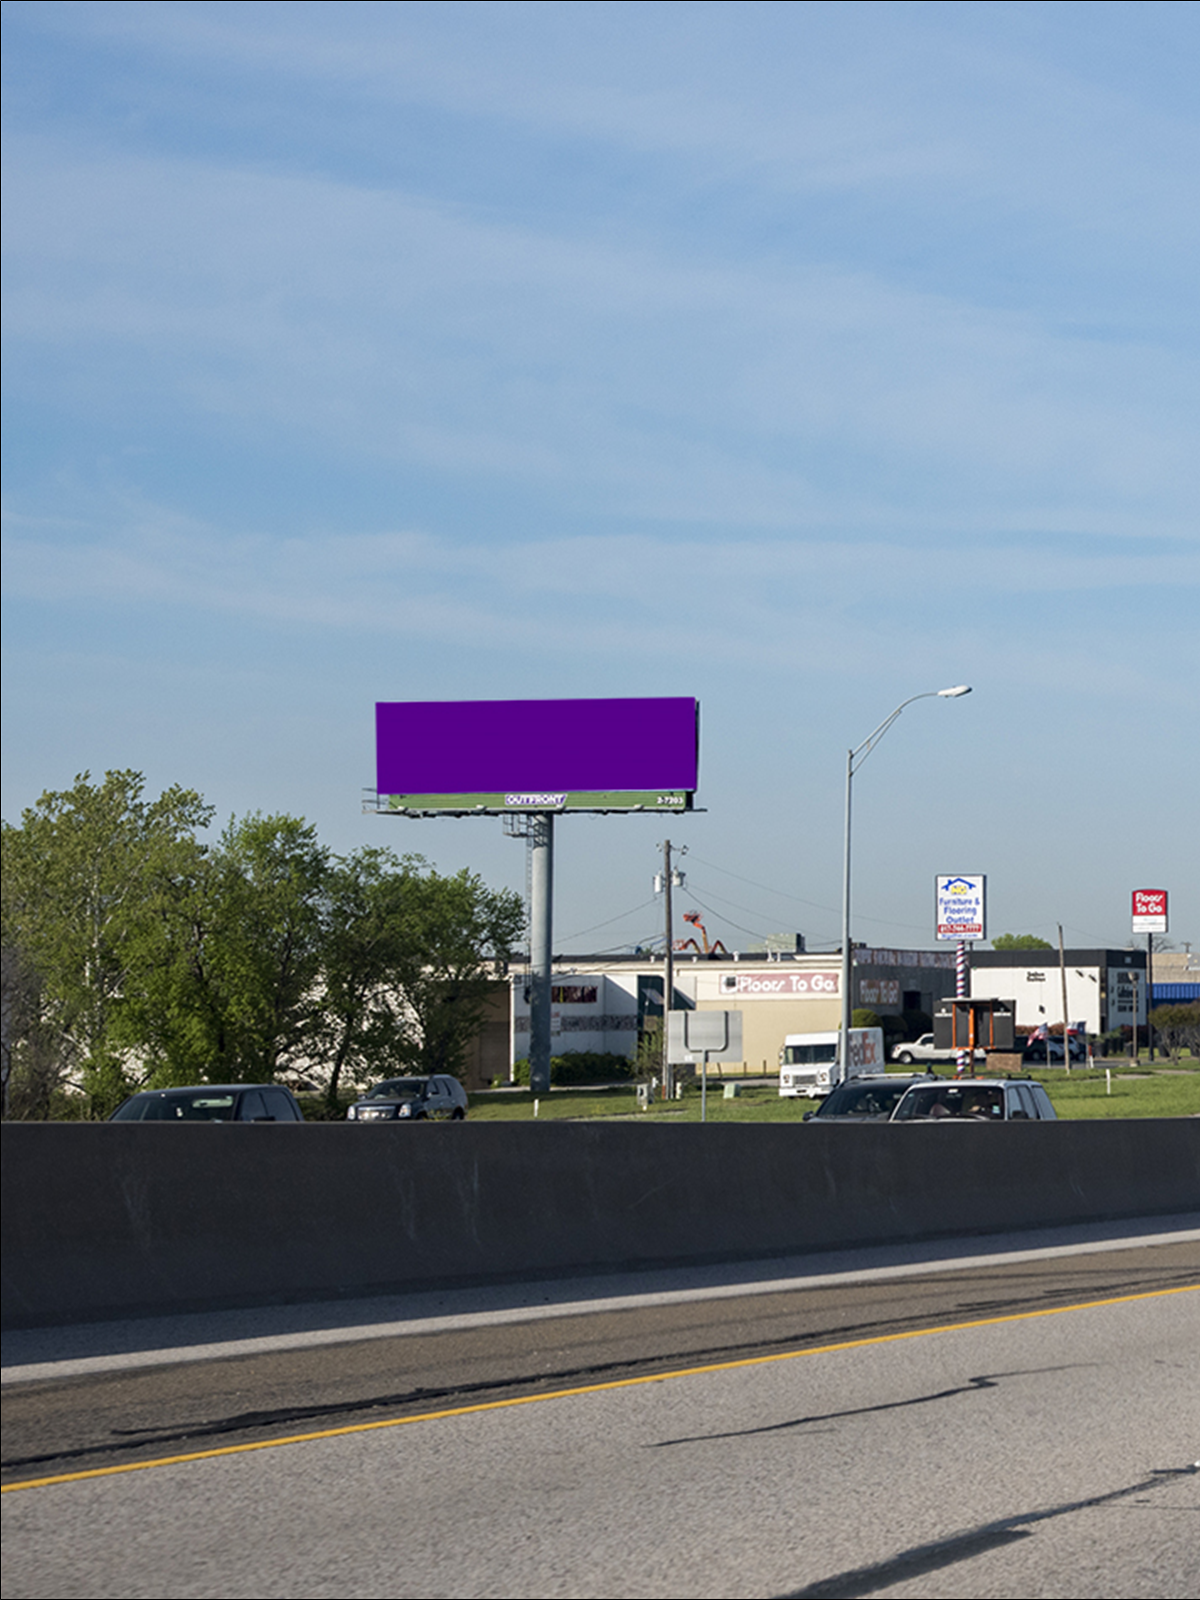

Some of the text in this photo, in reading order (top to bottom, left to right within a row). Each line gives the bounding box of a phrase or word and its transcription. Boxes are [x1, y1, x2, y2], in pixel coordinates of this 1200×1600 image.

[505, 793, 567, 805] OUTFRONT
[939, 897, 981, 905] Furniture &
[1135, 892, 1163, 902] Floors
[943, 907, 977, 916] Flooring
[945, 915, 974, 924] Outlet
[738, 975, 835, 993] Floors To Go
